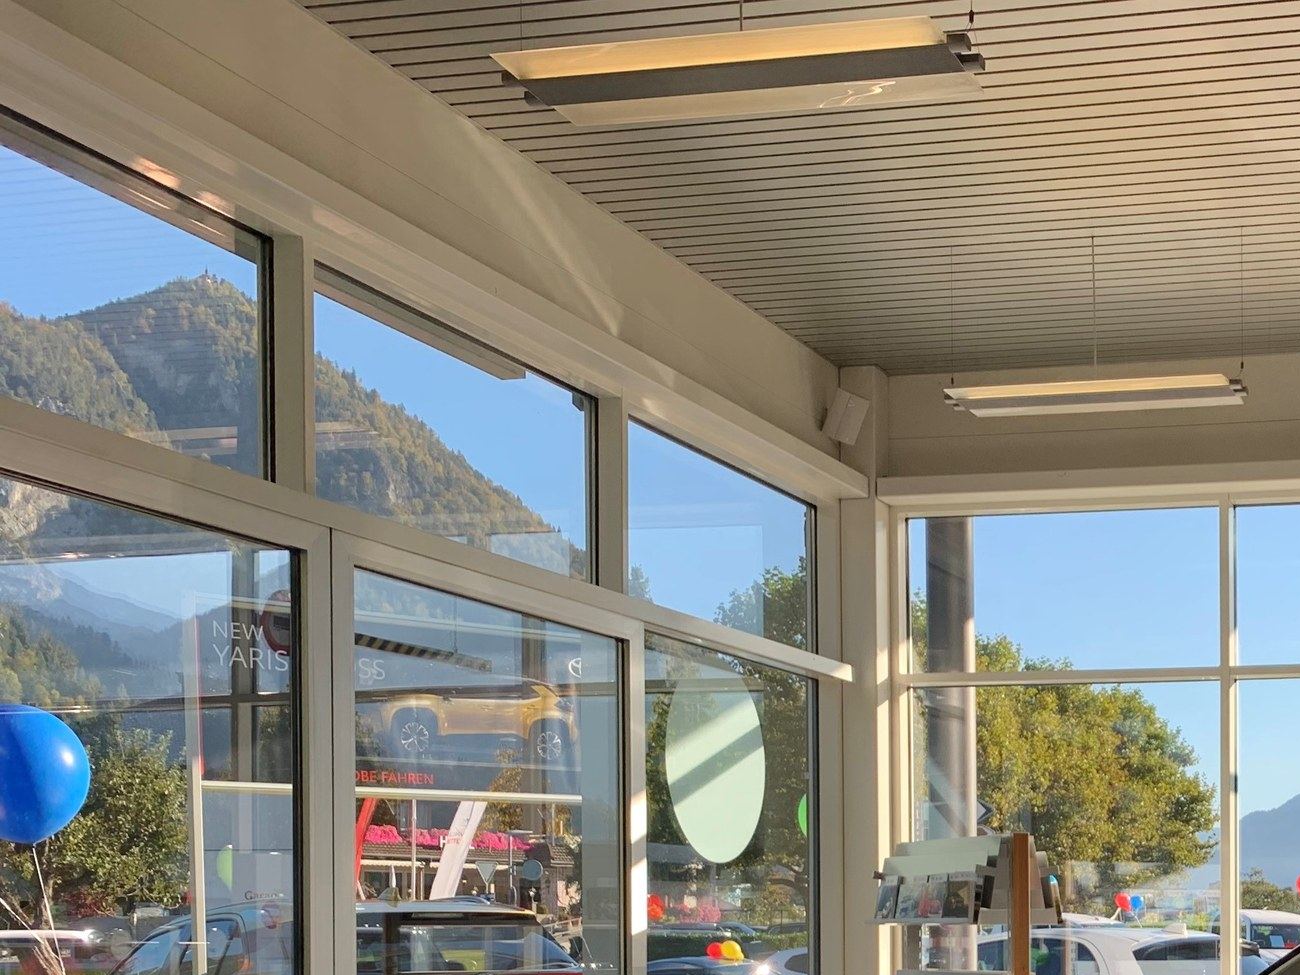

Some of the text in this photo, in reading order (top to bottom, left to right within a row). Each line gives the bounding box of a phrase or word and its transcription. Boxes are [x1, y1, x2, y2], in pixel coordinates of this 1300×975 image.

[213, 621, 264, 642] NEW
[212, 644, 289, 672] YARIS
[381, 772, 434, 785] FAHREN
